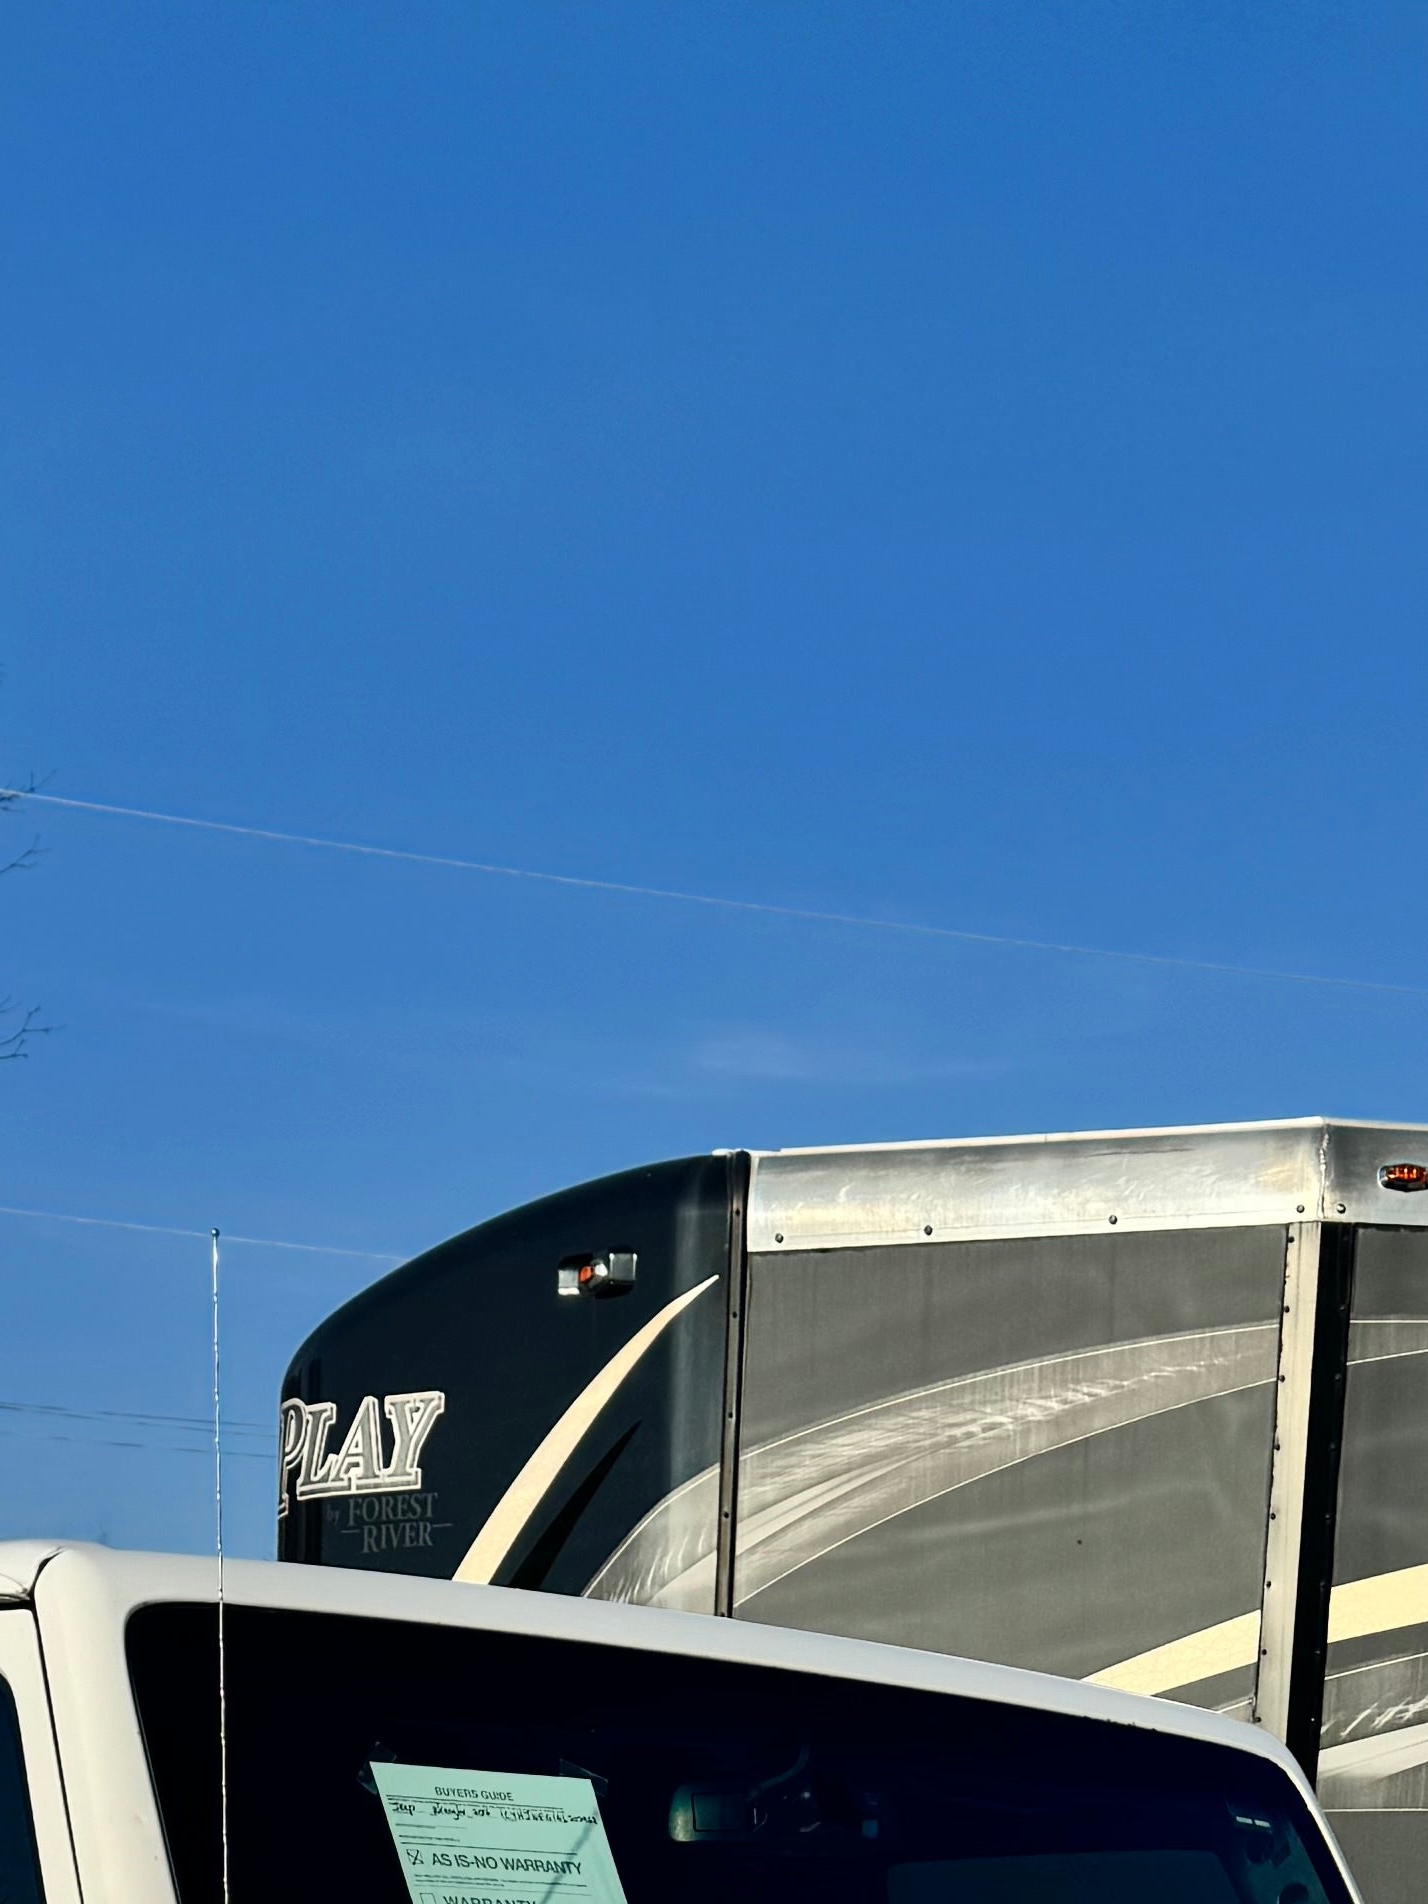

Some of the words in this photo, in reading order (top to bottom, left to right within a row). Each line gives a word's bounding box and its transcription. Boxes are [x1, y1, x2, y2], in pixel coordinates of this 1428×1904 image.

[278, 1391, 446, 1519] PLAY
[326, 1504, 340, 1525] by
[348, 1492, 439, 1527] FOREST
[362, 1521, 433, 1553] RIVER
[434, 1786, 479, 1799] BUYERS
[481, 1790, 514, 1801] GUIDE
[431, 1852, 453, 1867] AS
[499, 1857, 582, 1875] WARRANTY
